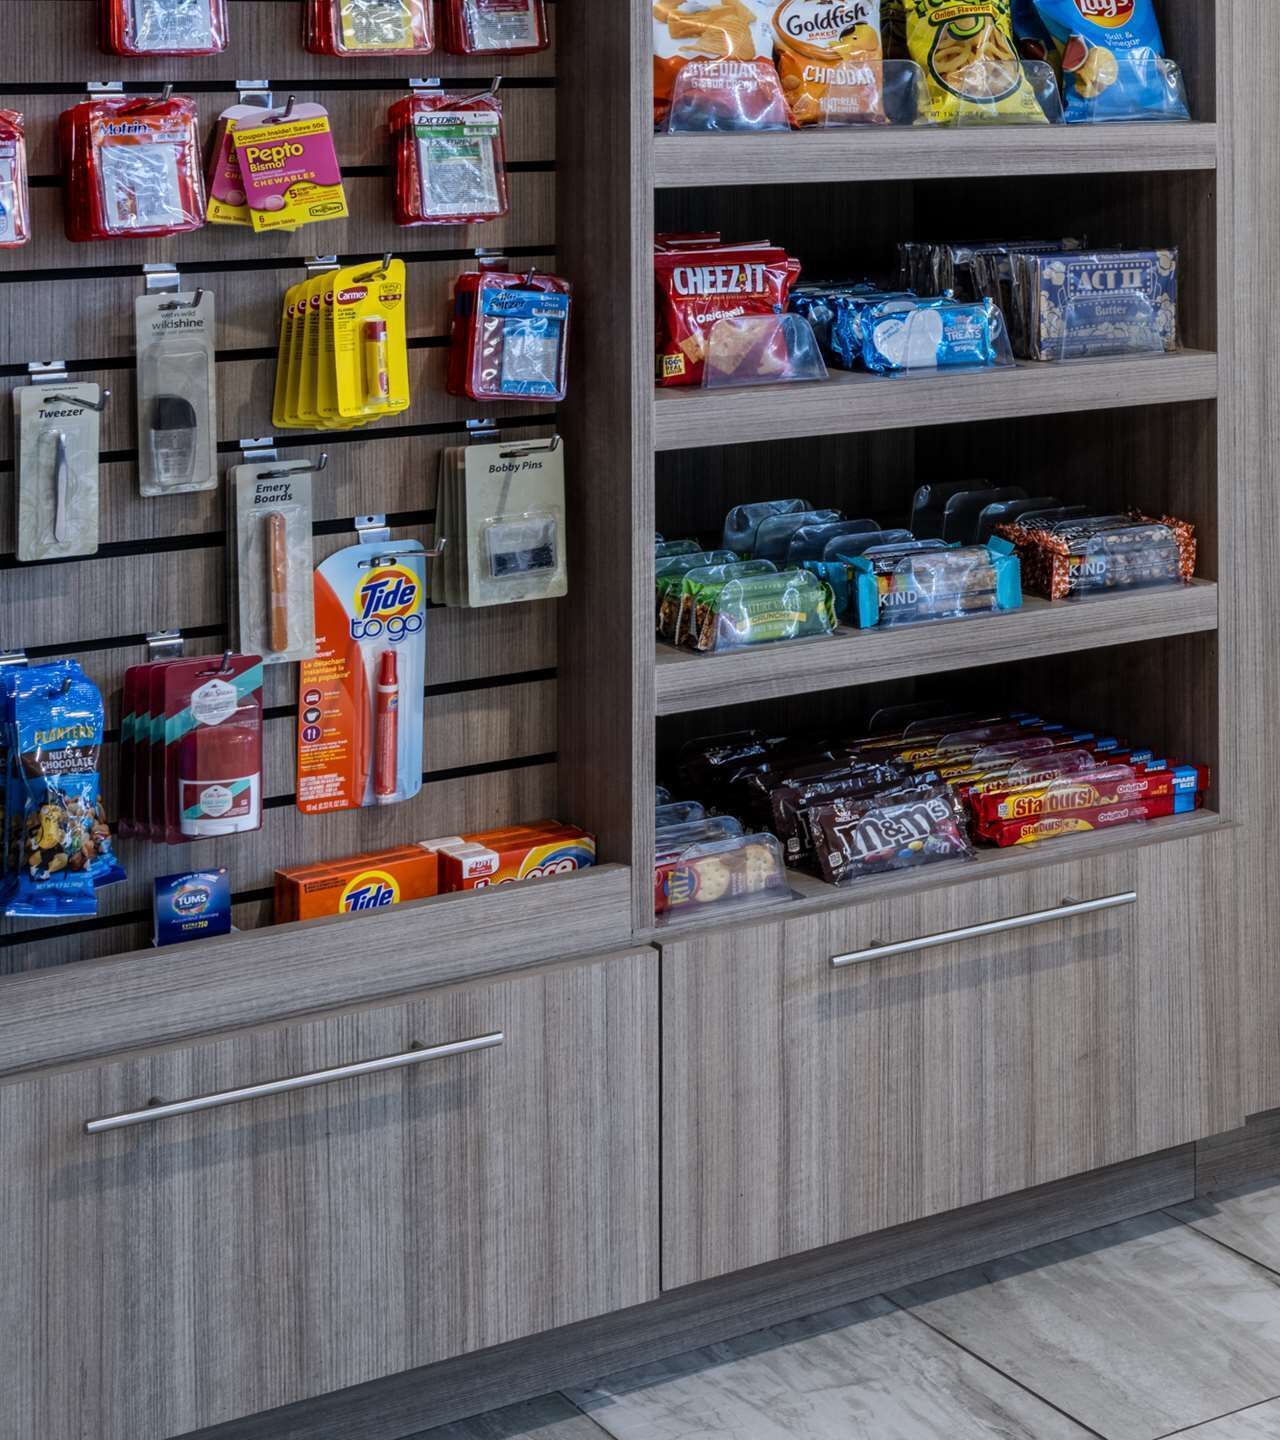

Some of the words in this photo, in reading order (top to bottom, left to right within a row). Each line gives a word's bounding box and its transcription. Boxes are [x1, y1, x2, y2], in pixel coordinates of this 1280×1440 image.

[786, 3, 867, 36] Goldfish
[934, 11, 956, 20] Onion
[1104, 38, 1140, 48] Vinegar
[101, 120, 148, 136] Motrin
[293, 124, 311, 132] Save
[246, 142, 304, 165] Pepto
[249, 160, 285, 173] Bismol
[253, 171, 316, 188] CHEWABLES
[289, 189, 297, 199] 5
[1077, 270, 1117, 290] ACT
[1121, 269, 1143, 287] II
[337, 292, 367, 301] Carmex
[1095, 305, 1127, 316] Butter
[152, 319, 203, 330] wildshine
[38, 408, 84, 419] Tweezer
[489, 463, 519, 474] Bobby
[522, 461, 543, 469] Pins
[256, 482, 291, 496] Emery
[254, 492, 293, 505] Boards
[1070, 561, 1106, 576] KIND
[361, 578, 417, 620] Tide
[879, 591, 918, 606] KIND
[350, 617, 382, 640] to
[387, 613, 422, 642] go
[34, 725, 95, 746] PLANTERS
[49, 750, 74, 760] NUTS
[40, 757, 95, 769] CHOCOLATE
[1118, 781, 1148, 793] Original
[1015, 787, 1094, 817] Starburst
[1098, 808, 1128, 822] Original
[834, 799, 950, 860] m&m's
[1021, 819, 1063, 837] Starburst
[178, 894, 207, 906] TUMS
[345, 884, 394, 912] Tide
